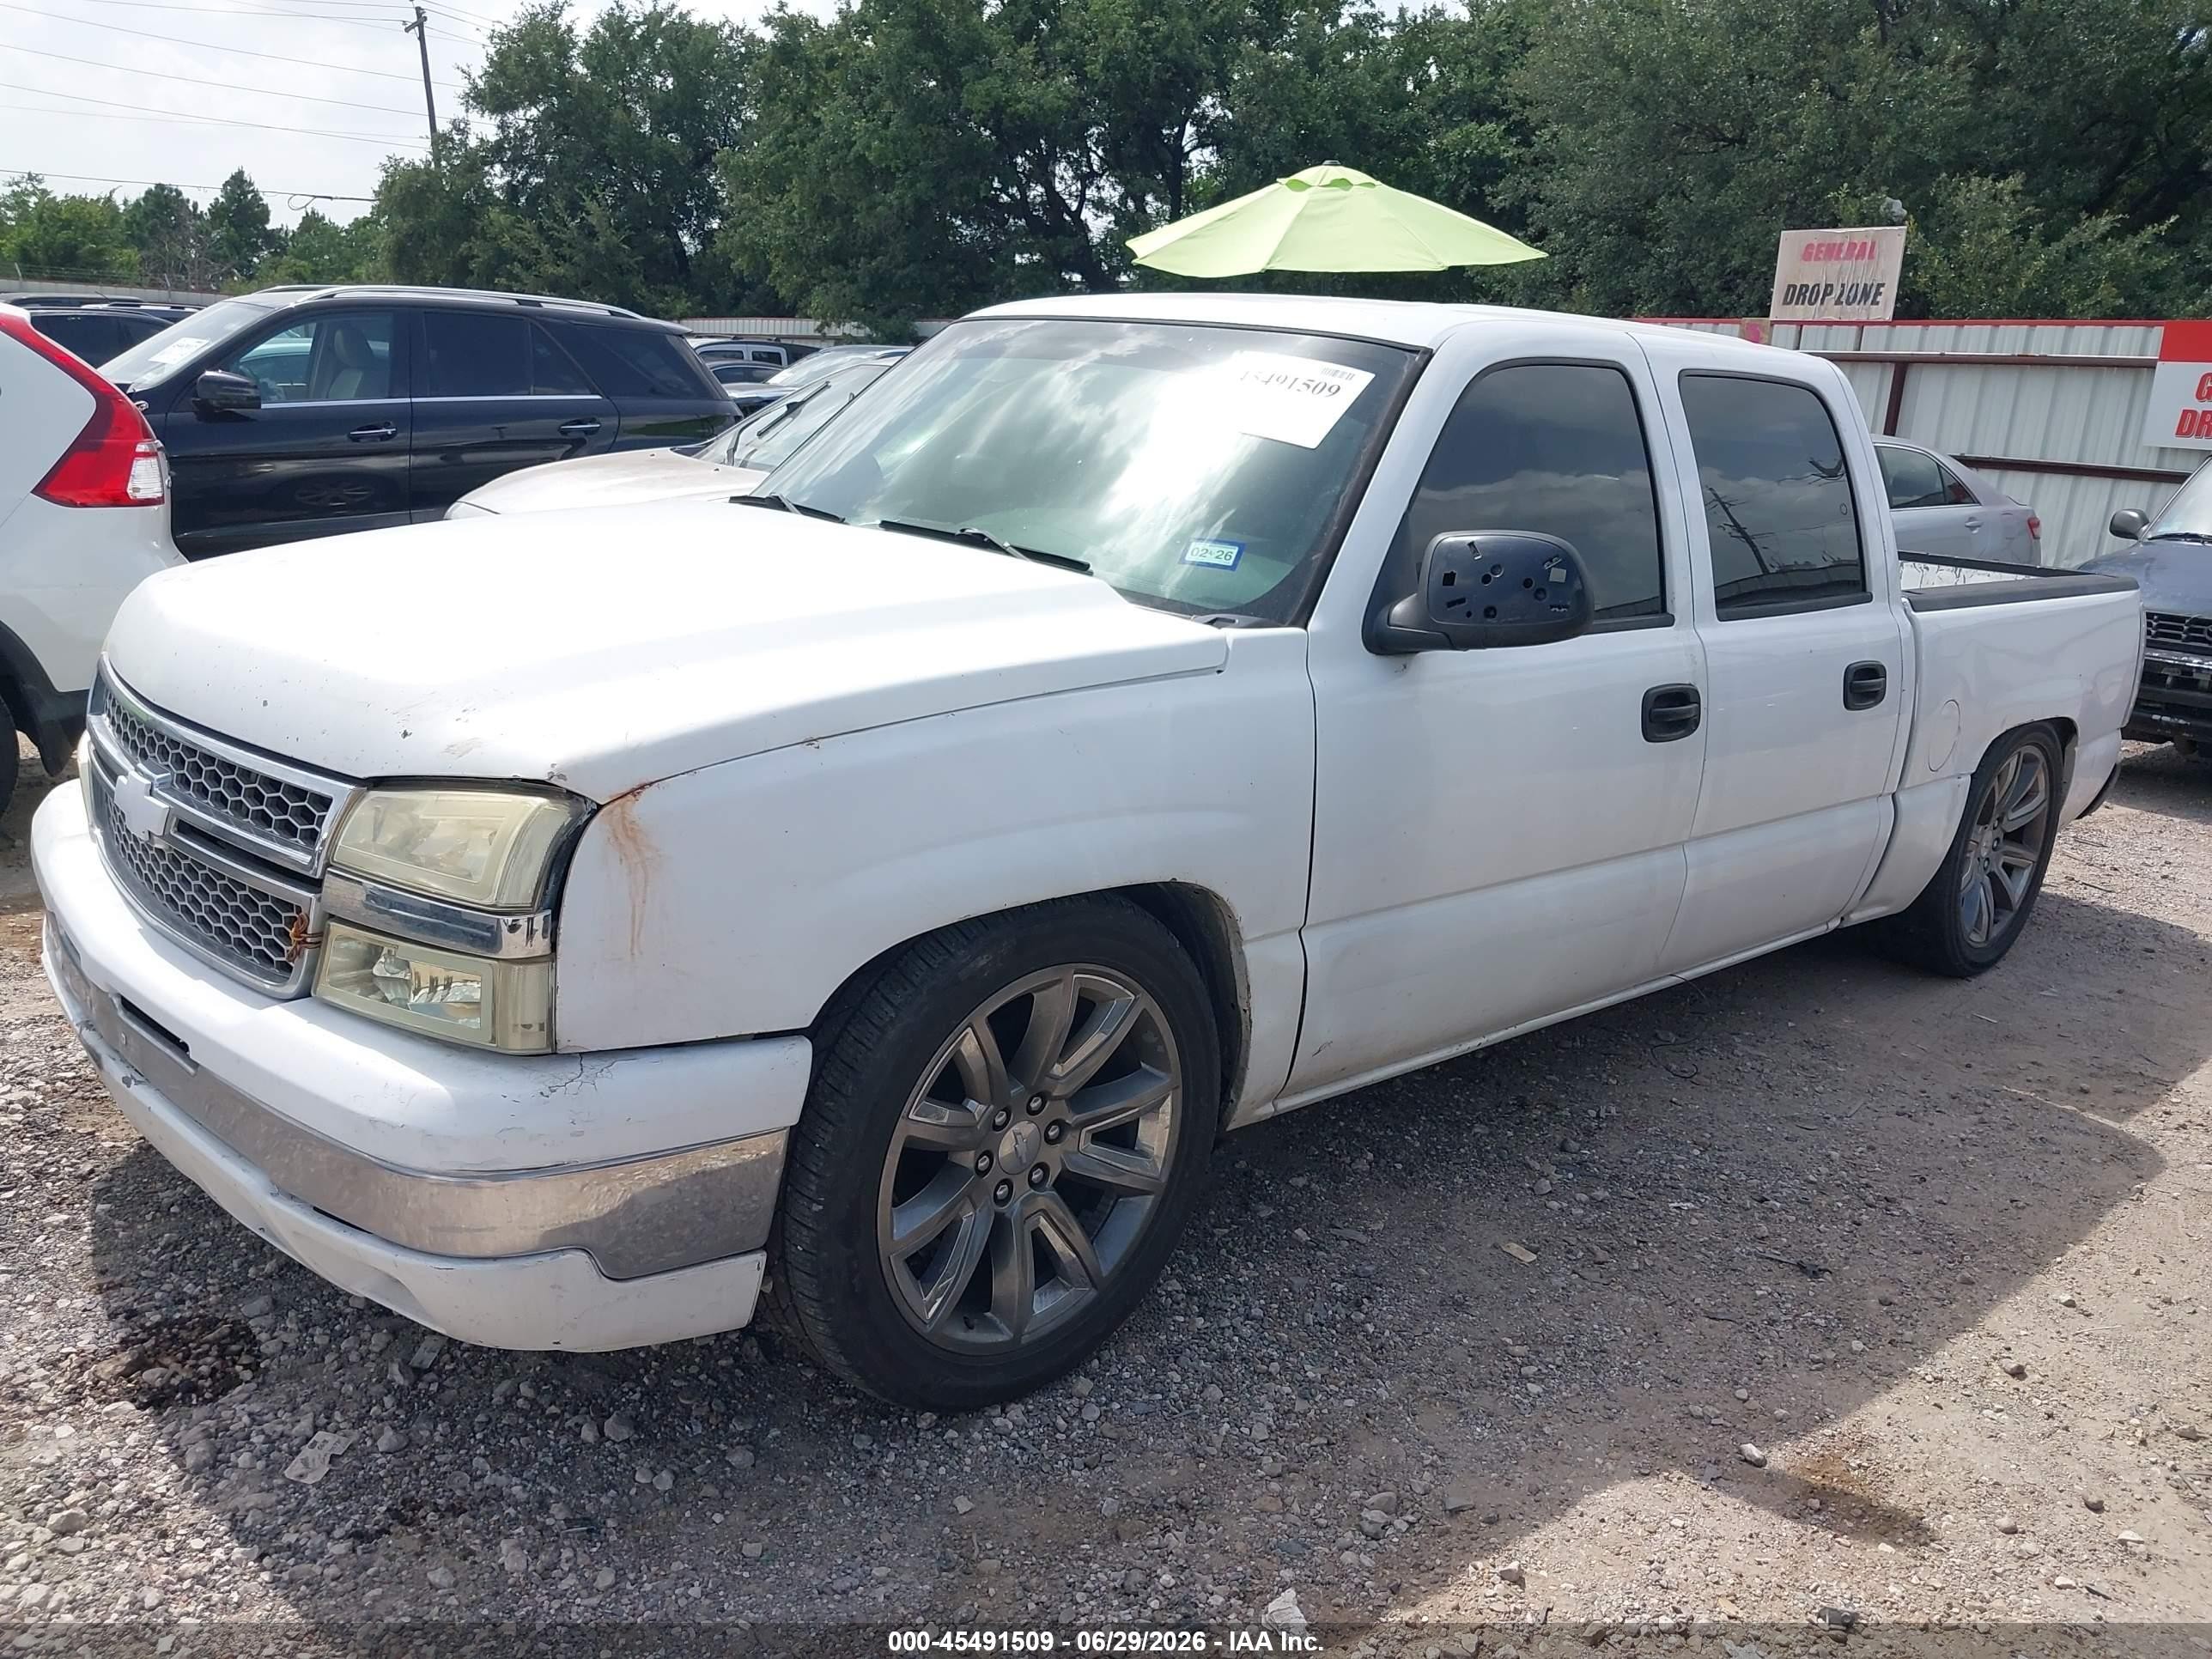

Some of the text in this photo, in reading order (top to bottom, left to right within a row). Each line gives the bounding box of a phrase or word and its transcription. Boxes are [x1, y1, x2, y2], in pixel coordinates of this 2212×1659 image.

[1801, 240, 1877, 262] GENERAL
[1782, 282, 1886, 306] DROP ZONE
[1215, 550, 1234, 562] 26
